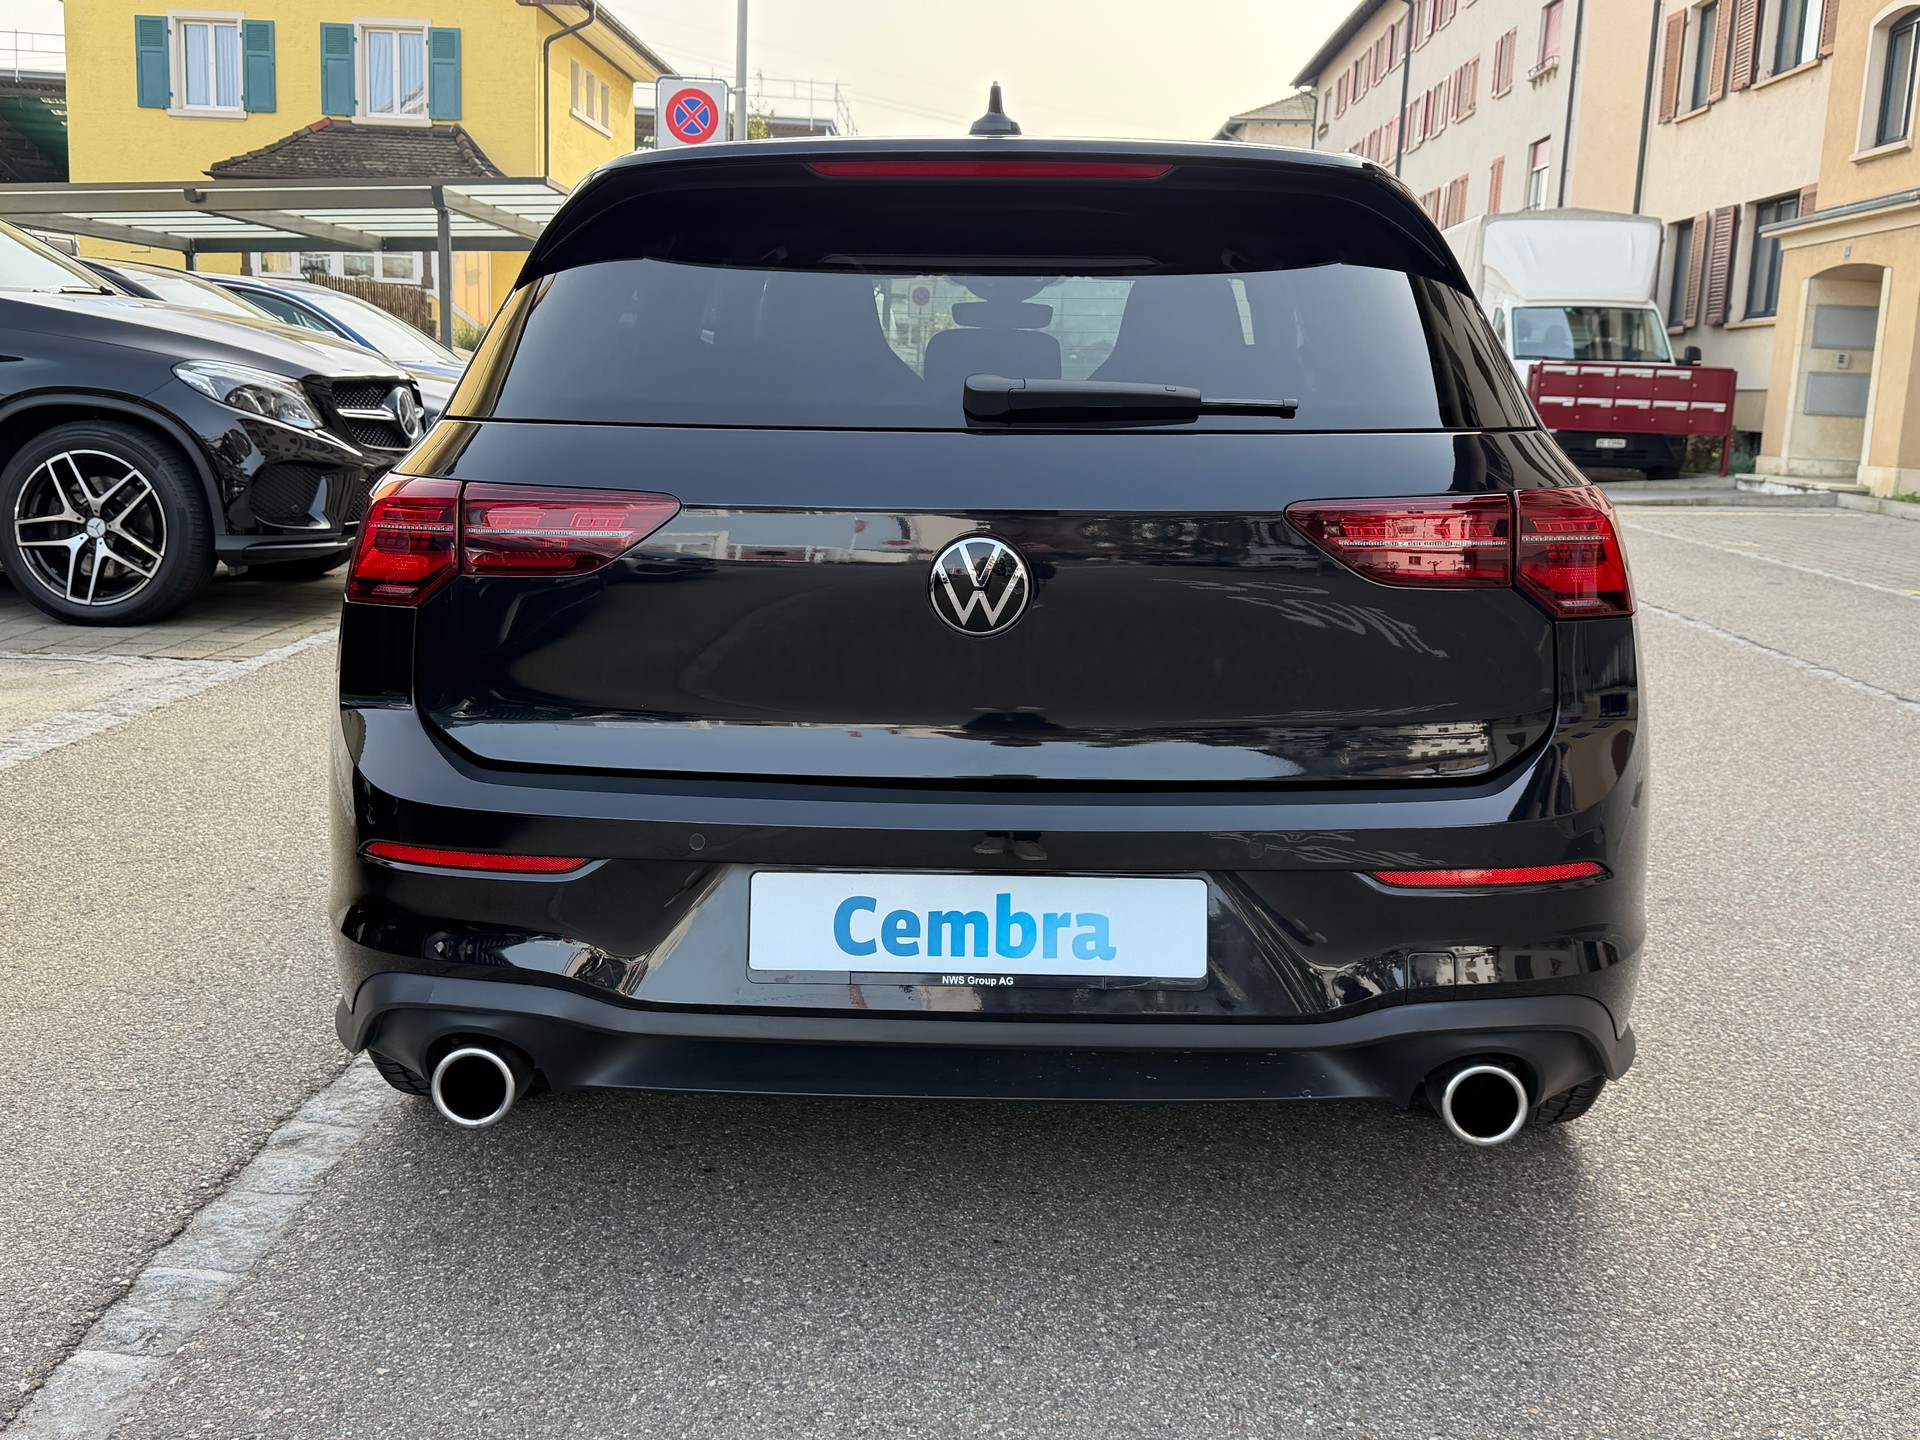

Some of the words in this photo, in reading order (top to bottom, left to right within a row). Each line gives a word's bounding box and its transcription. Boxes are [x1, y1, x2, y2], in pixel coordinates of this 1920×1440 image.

[930, 537, 1029, 636] VW
[833, 893, 1117, 961] Cembra
[942, 975, 965, 985] NWS
[967, 976, 997, 987] Group
[998, 976, 1014, 986] AG
